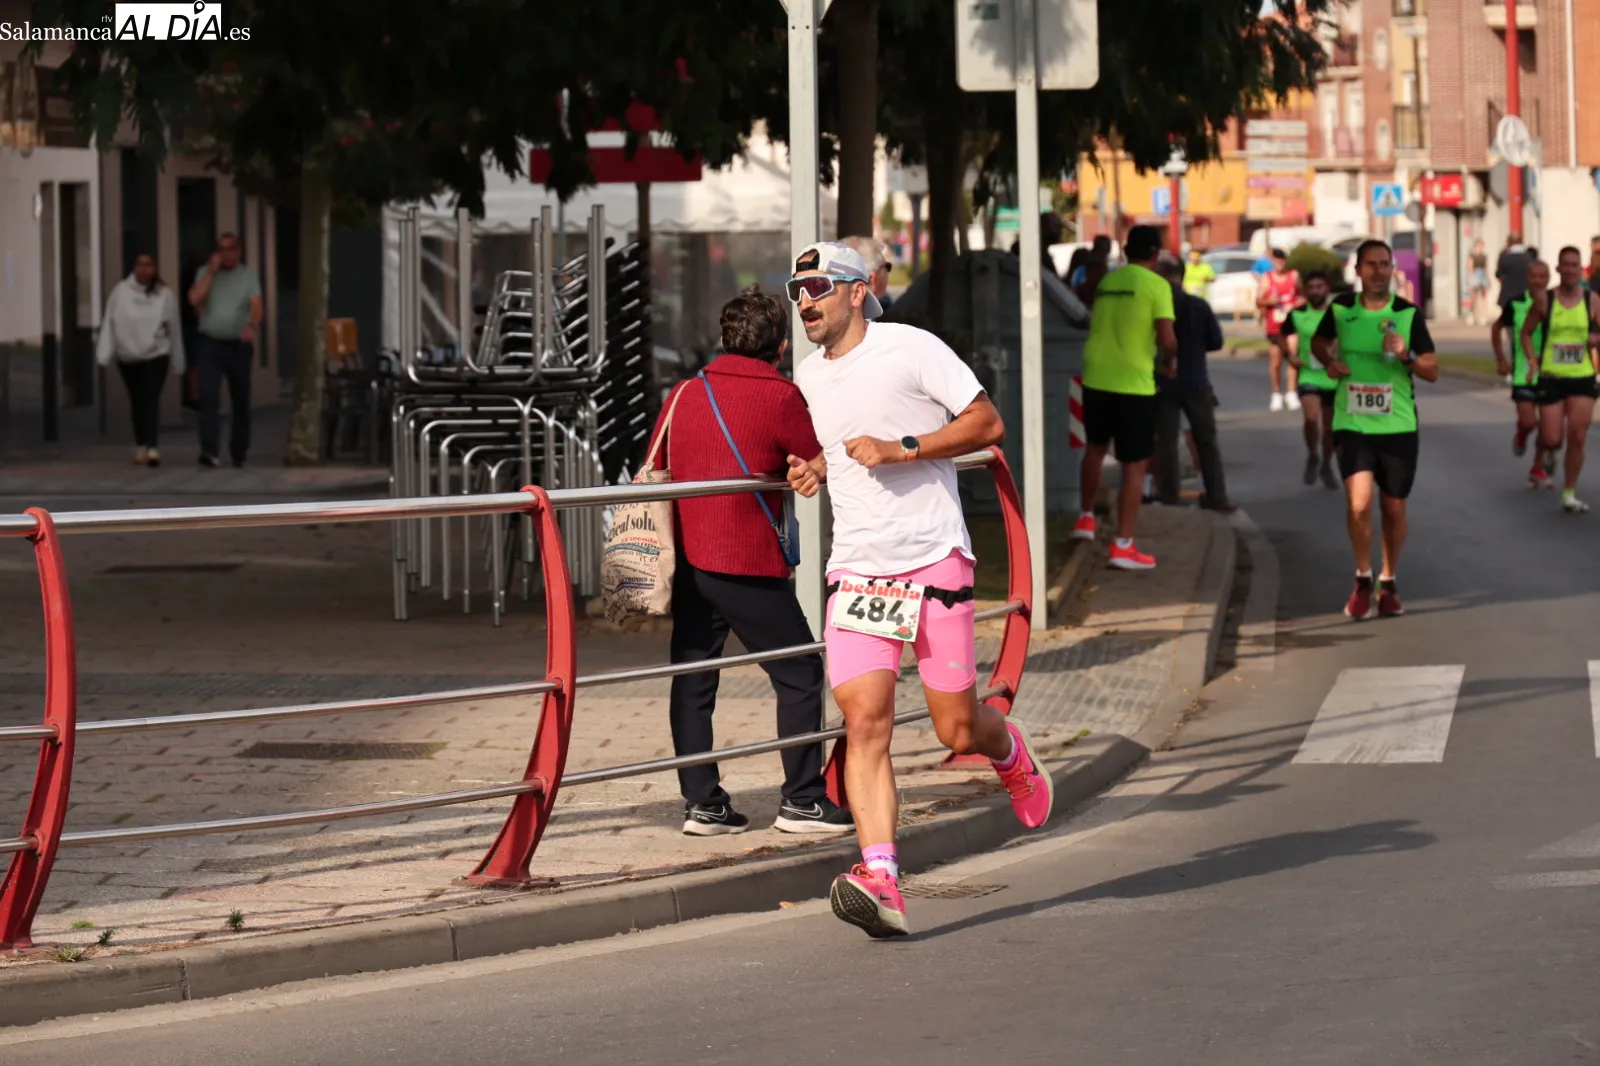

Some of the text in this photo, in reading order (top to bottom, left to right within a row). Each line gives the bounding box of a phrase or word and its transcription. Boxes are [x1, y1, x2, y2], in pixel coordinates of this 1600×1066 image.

[1356, 393, 1385, 408] 180
[841, 579, 921, 600] bedunia
[847, 595, 905, 626] 484
